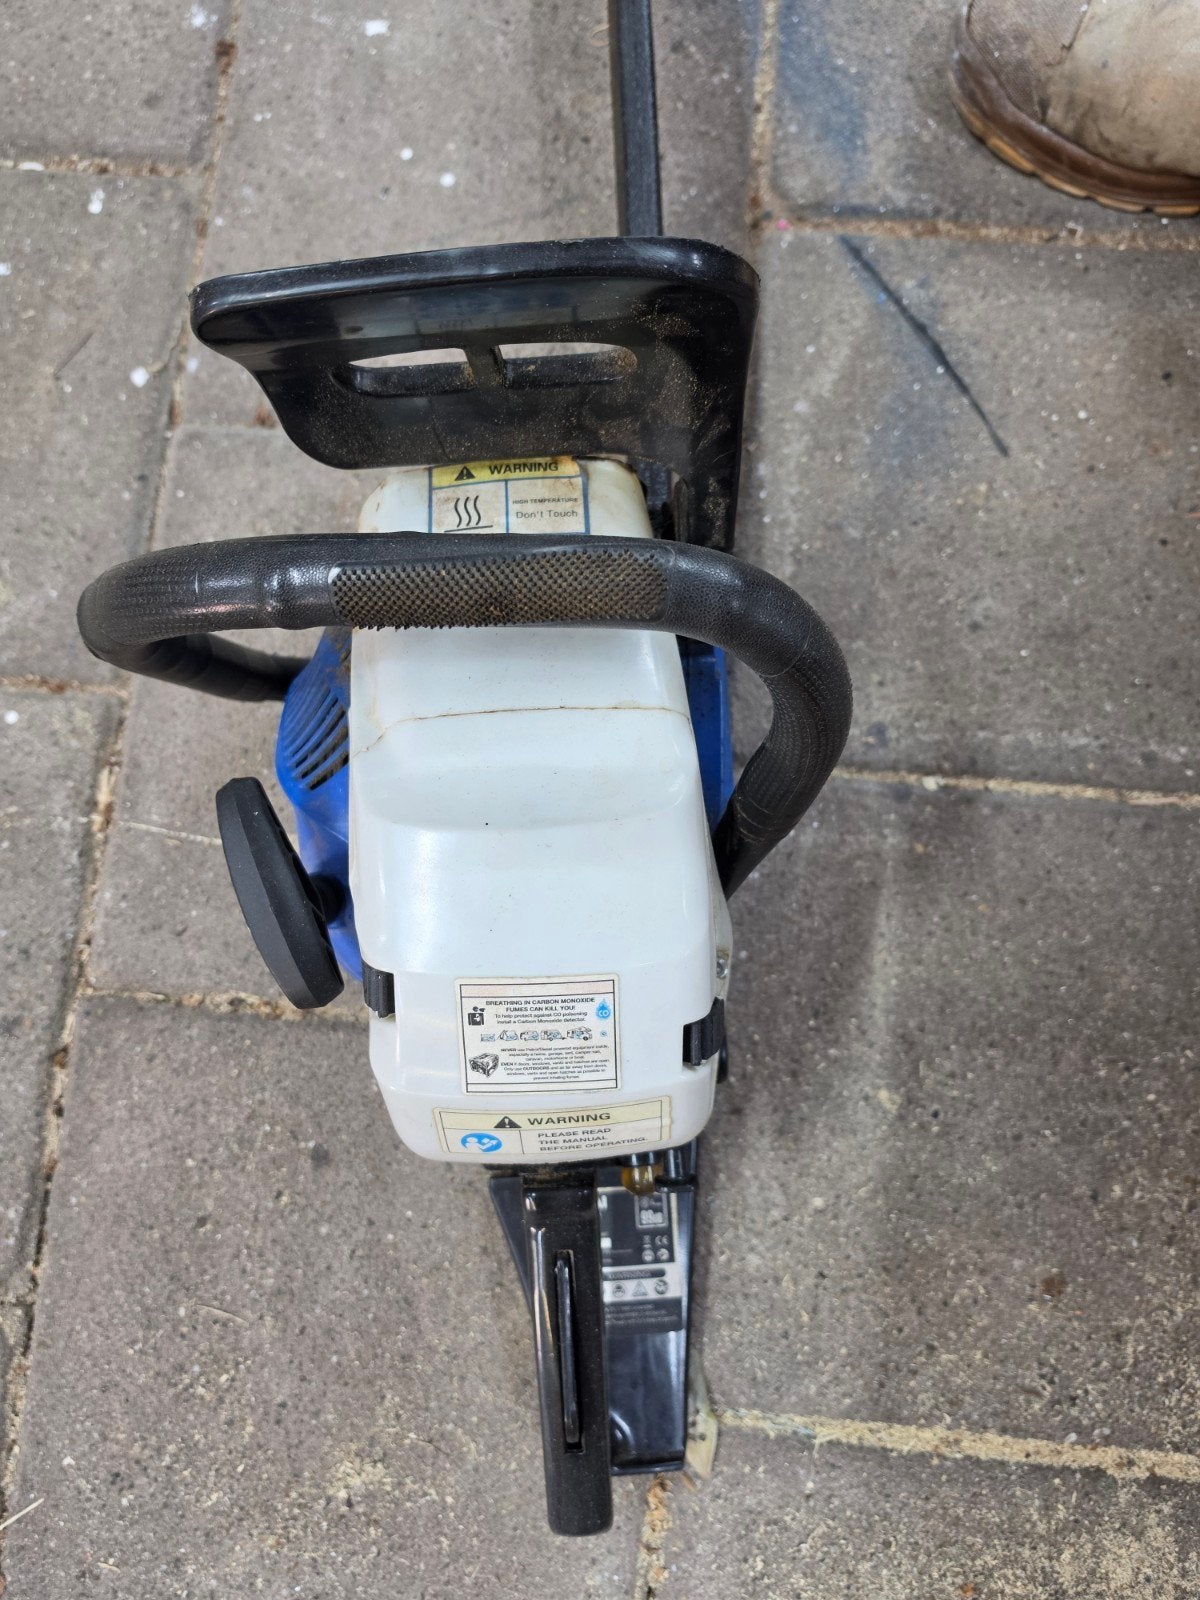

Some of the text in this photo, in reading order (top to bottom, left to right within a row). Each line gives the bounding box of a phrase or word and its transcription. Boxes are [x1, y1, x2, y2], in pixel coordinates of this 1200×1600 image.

[489, 462, 559, 475] WARNING
[516, 509, 578, 519] Don't Touch
[528, 1113, 611, 1125] WARNING
[537, 1130, 579, 1138] PLEASE
[562, 1136, 607, 1144] MANUAL
